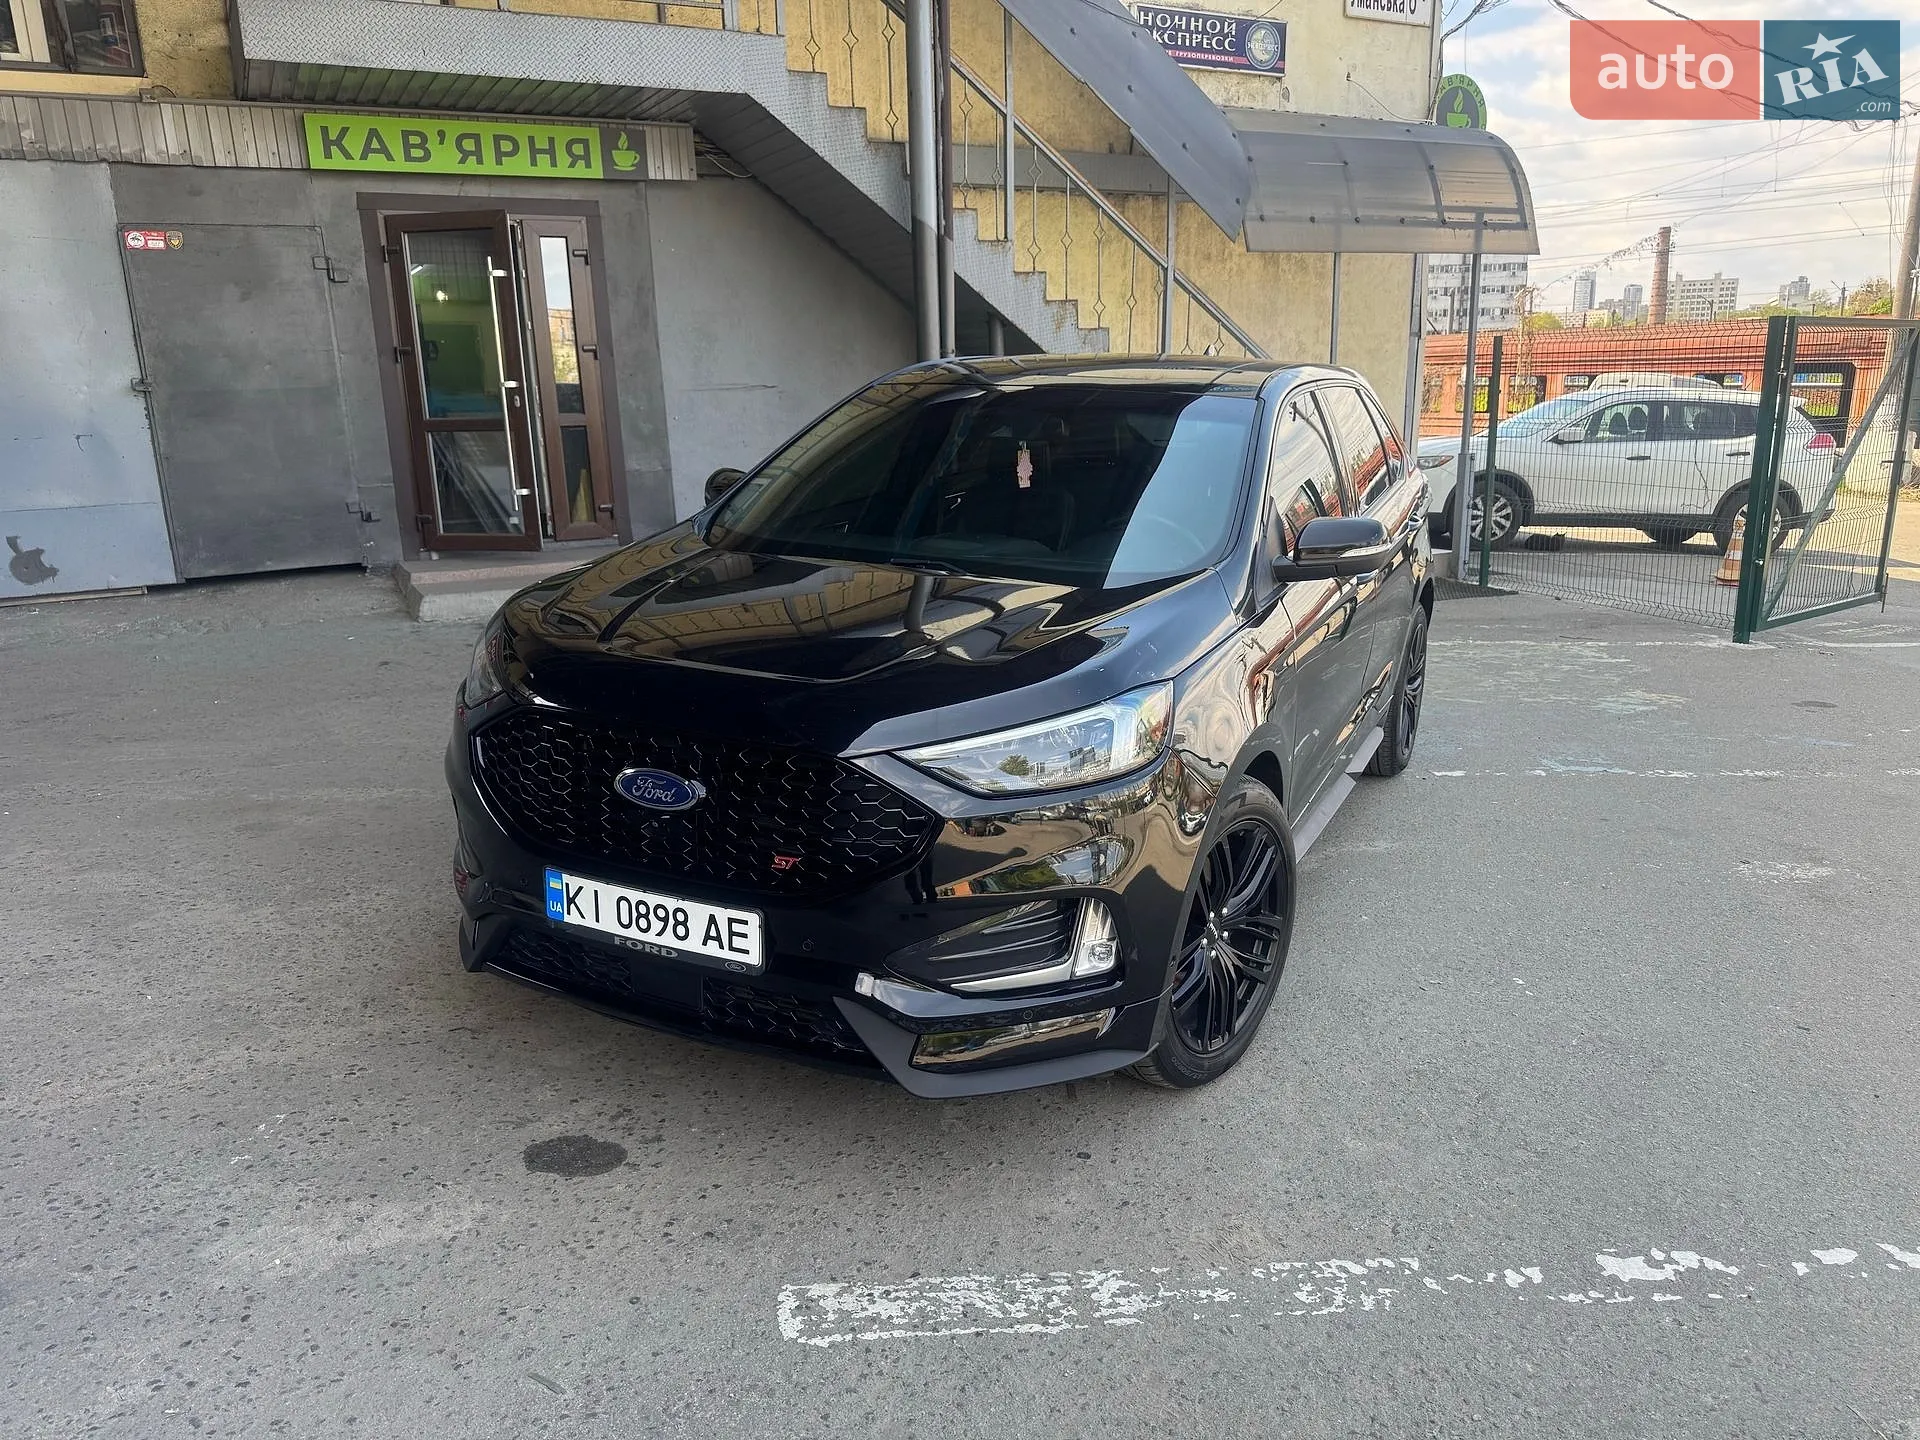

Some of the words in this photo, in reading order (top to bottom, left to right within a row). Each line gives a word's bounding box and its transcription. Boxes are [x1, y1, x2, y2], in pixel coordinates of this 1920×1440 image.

[319, 125, 593, 169] КАВ'ЯРНЯ
[632, 776, 678, 802] Ford
[771, 856, 800, 869] ST
[550, 900, 563, 913] UA
[565, 882, 601, 924] KI
[615, 895, 690, 942] 0898
[701, 913, 750, 955] AE
[614, 936, 679, 957] FORD
